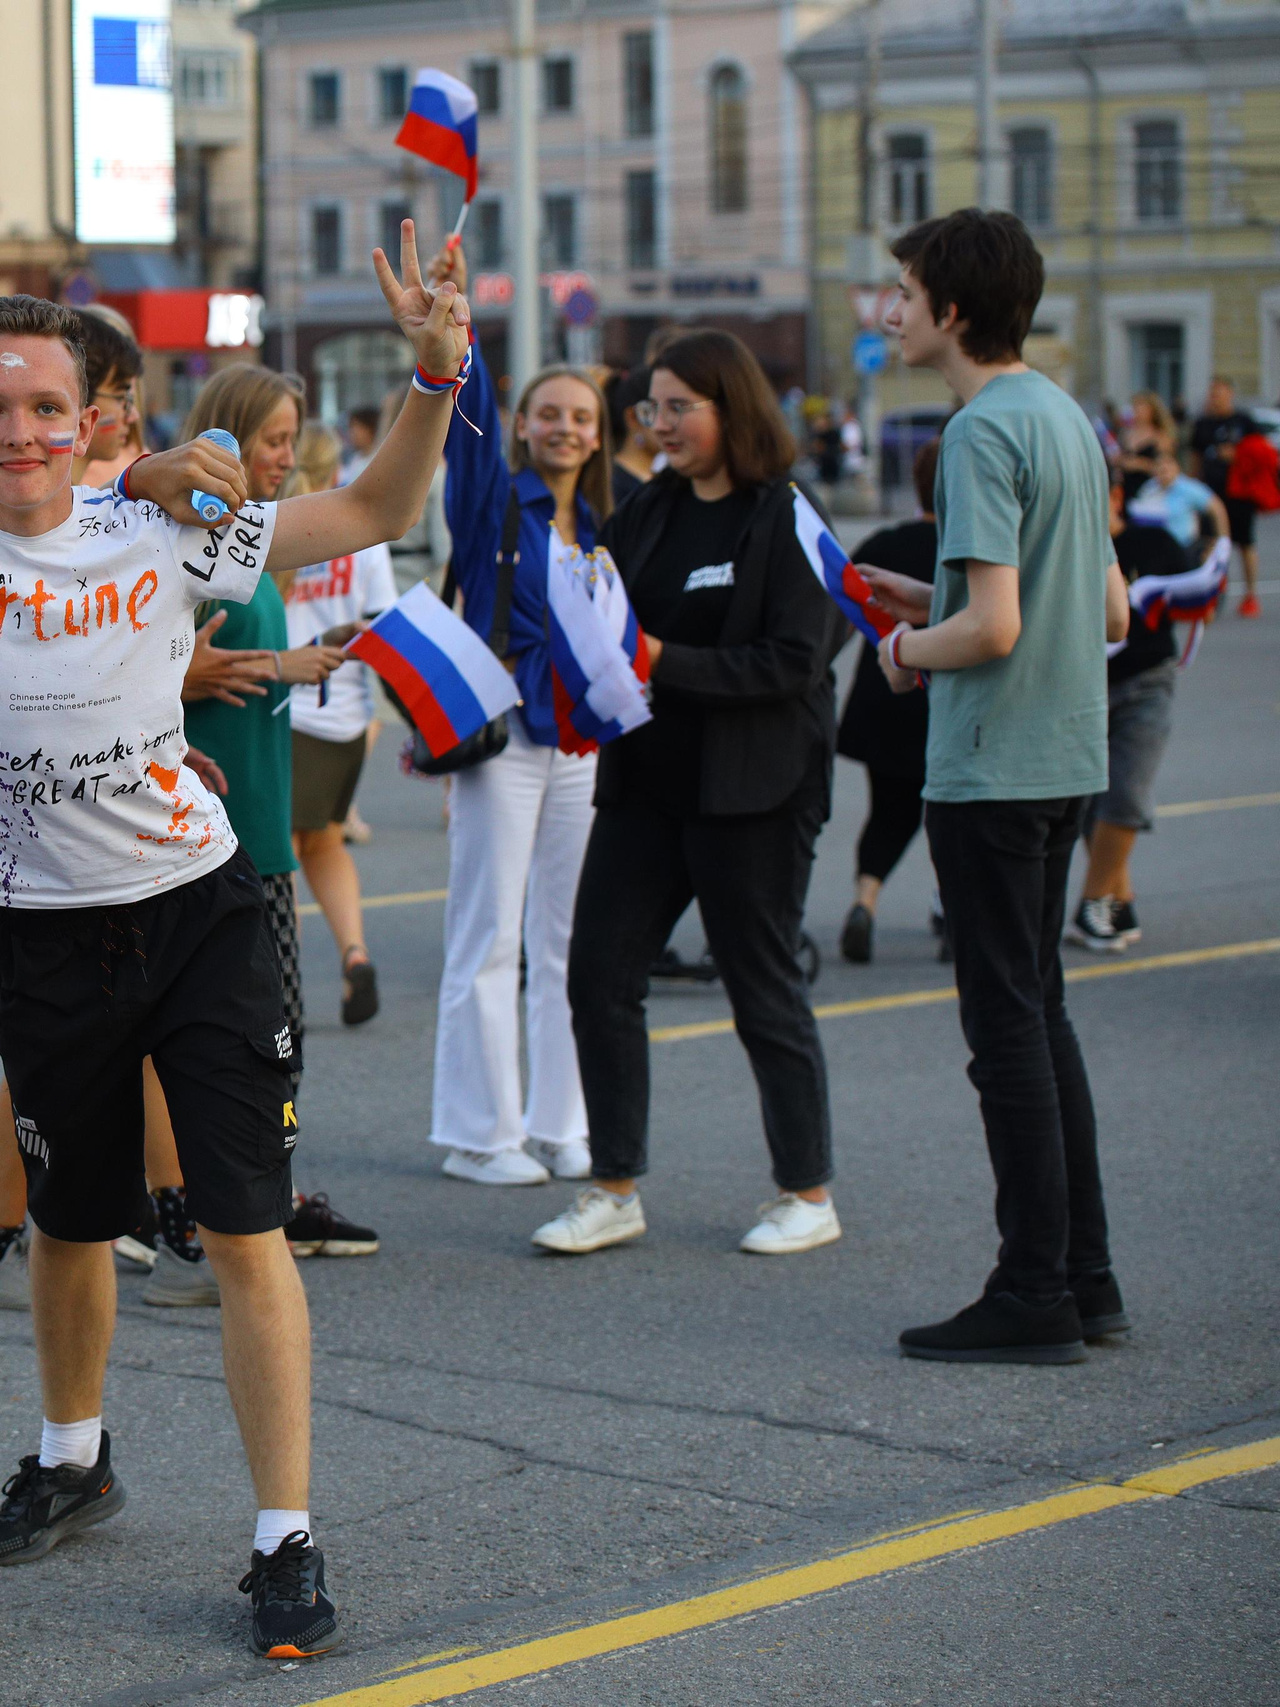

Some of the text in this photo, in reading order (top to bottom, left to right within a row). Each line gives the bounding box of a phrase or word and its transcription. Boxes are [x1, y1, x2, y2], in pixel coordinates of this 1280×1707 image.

[79, 515, 128, 538] 75001
[169, 637, 177, 662] 20XX
[8, 693, 122, 712] Celebrate Chinese Festivals
[9, 692, 76, 701] Chinese People
[69, 736, 134, 770] make
[12, 772, 110, 806] GREAT
